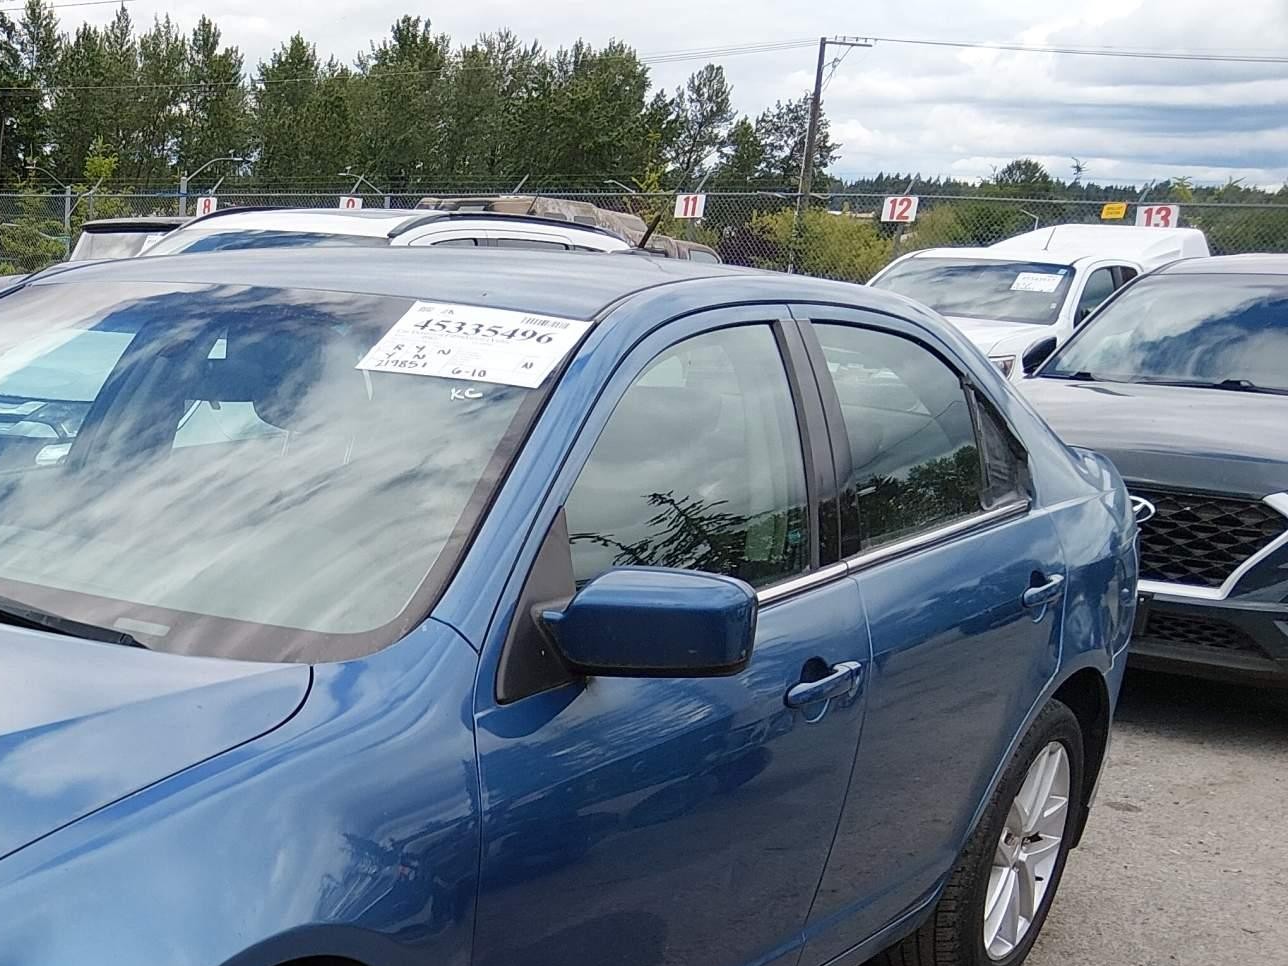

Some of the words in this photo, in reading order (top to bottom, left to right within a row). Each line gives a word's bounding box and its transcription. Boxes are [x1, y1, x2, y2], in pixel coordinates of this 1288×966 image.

[682, 196, 698, 217] 11
[888, 197, 912, 220] 12
[1144, 206, 1172, 227] 13
[413, 318, 554, 345] 45335496
